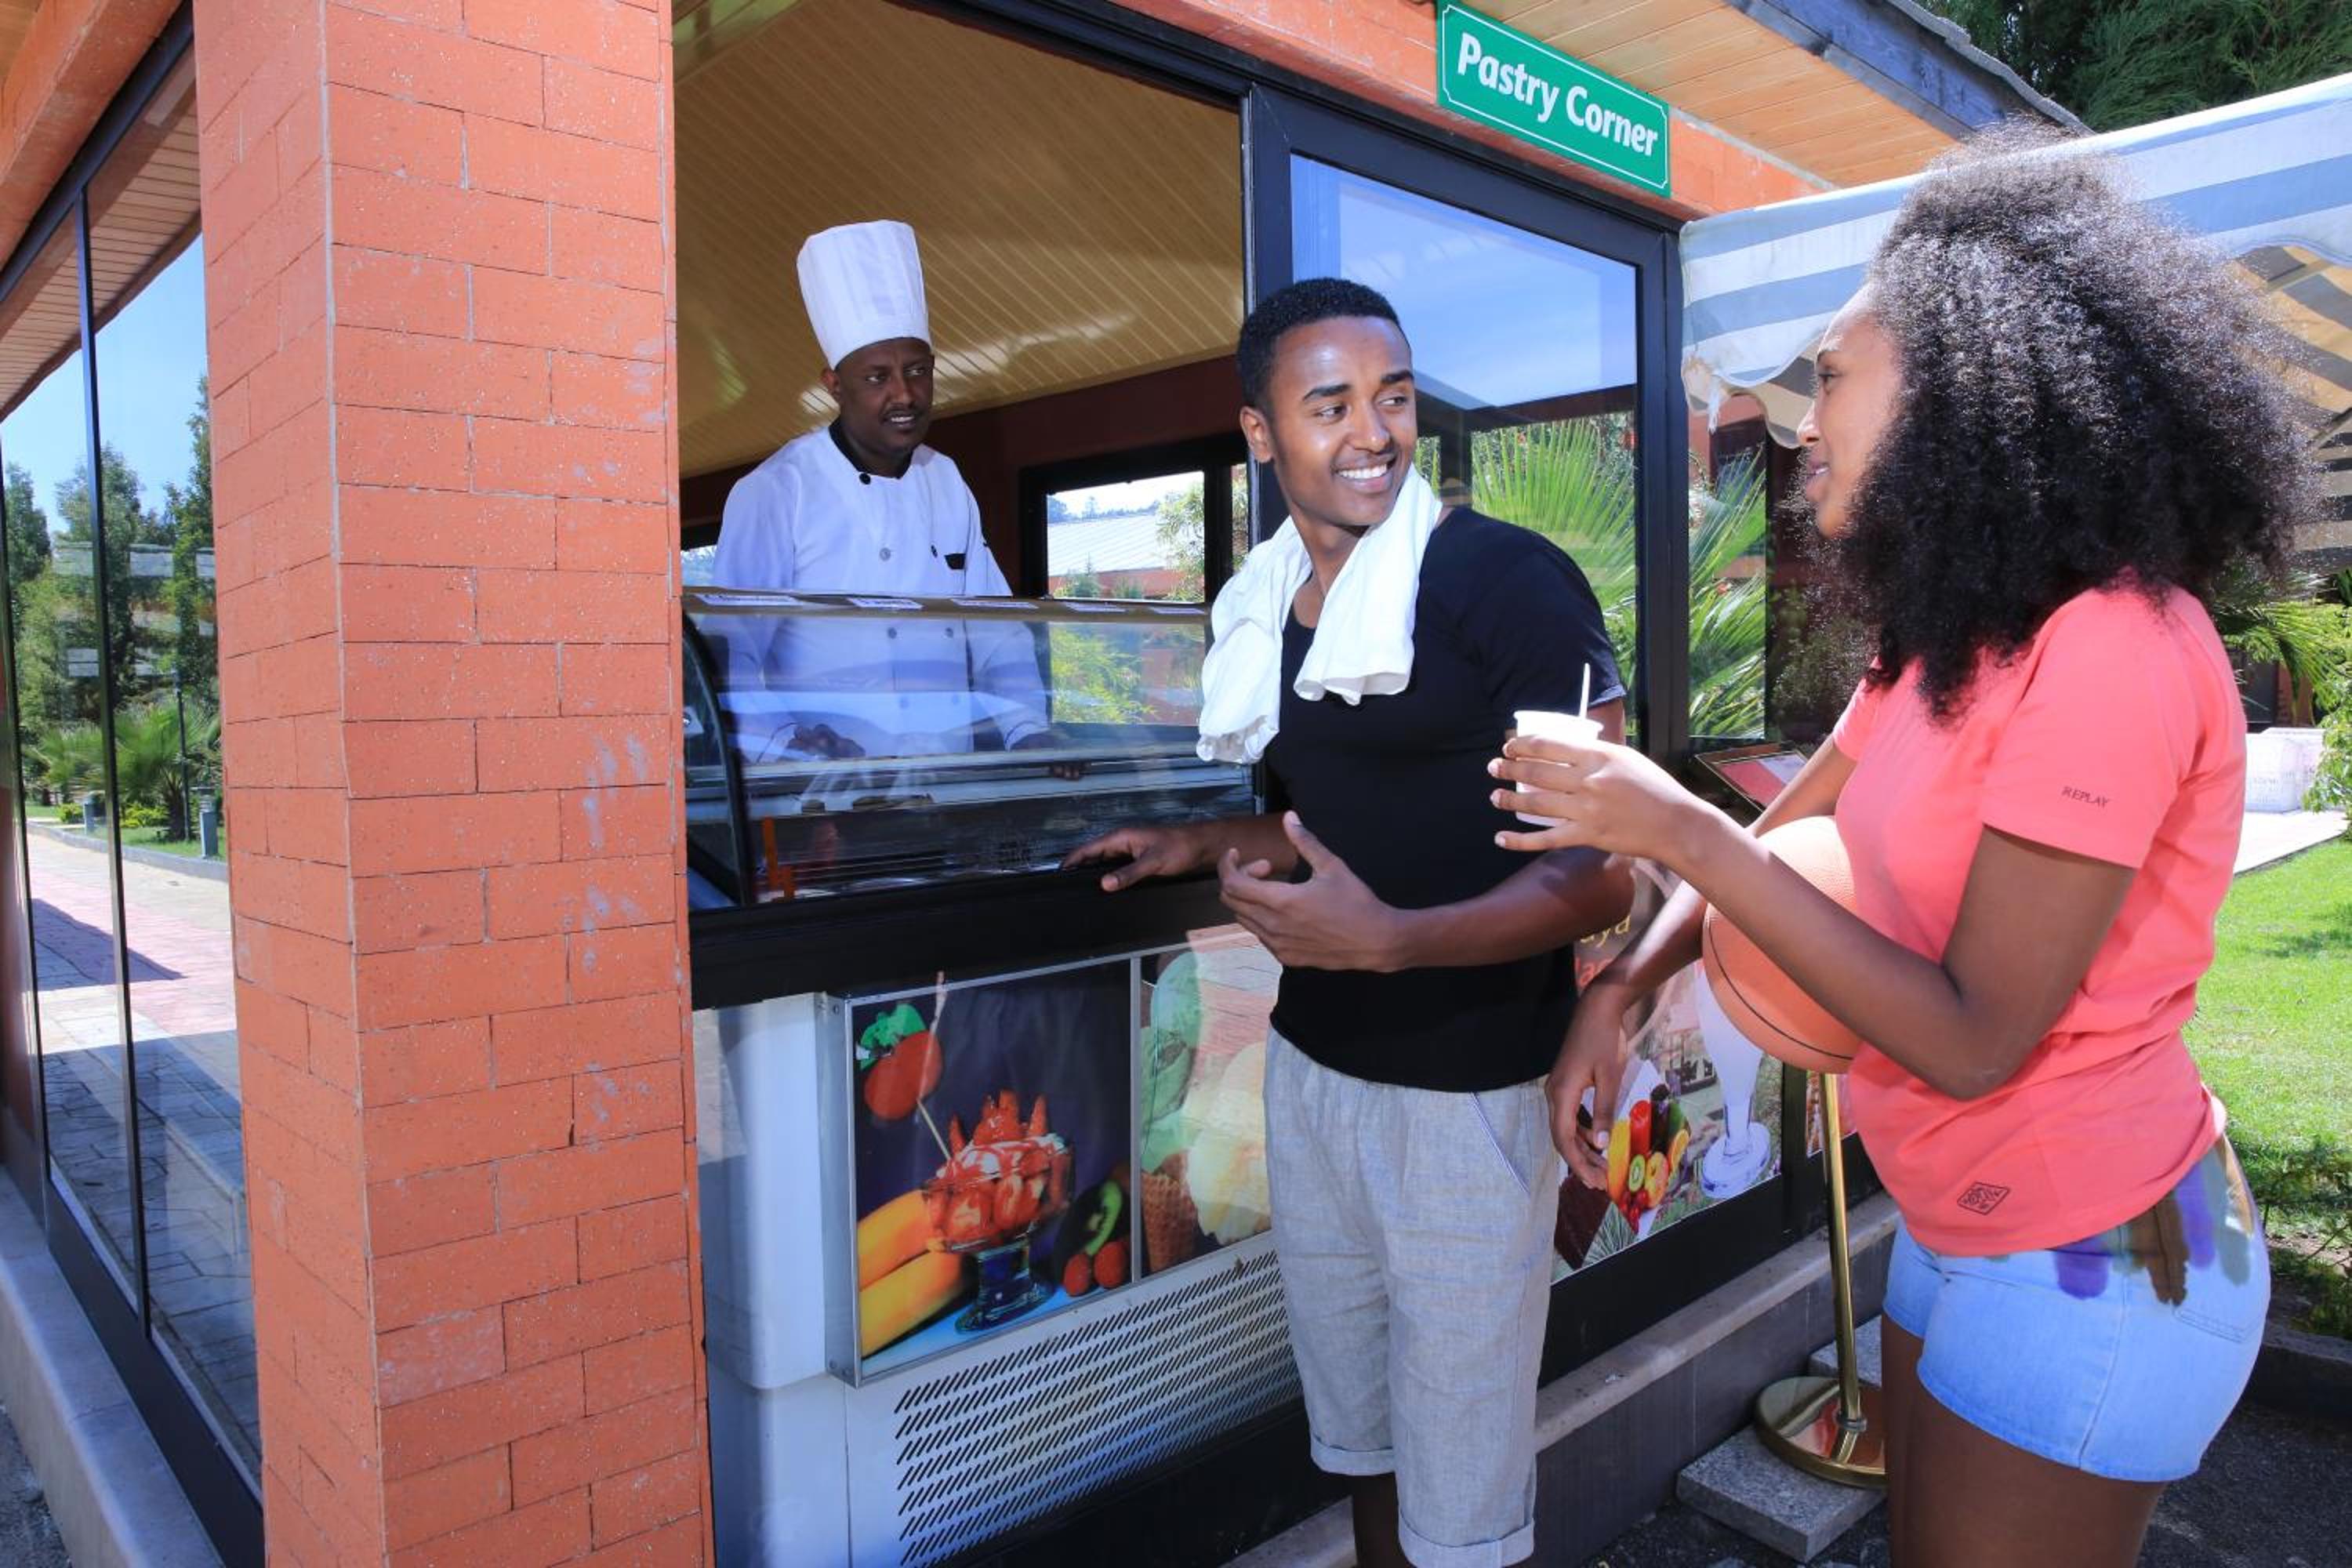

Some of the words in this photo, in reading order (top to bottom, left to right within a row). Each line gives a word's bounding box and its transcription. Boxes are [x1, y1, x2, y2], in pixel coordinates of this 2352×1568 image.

[1457, 32, 1559, 122] Pastry
[1566, 85, 1658, 156] Corner
[2061, 786, 2111, 808] REPLAY
